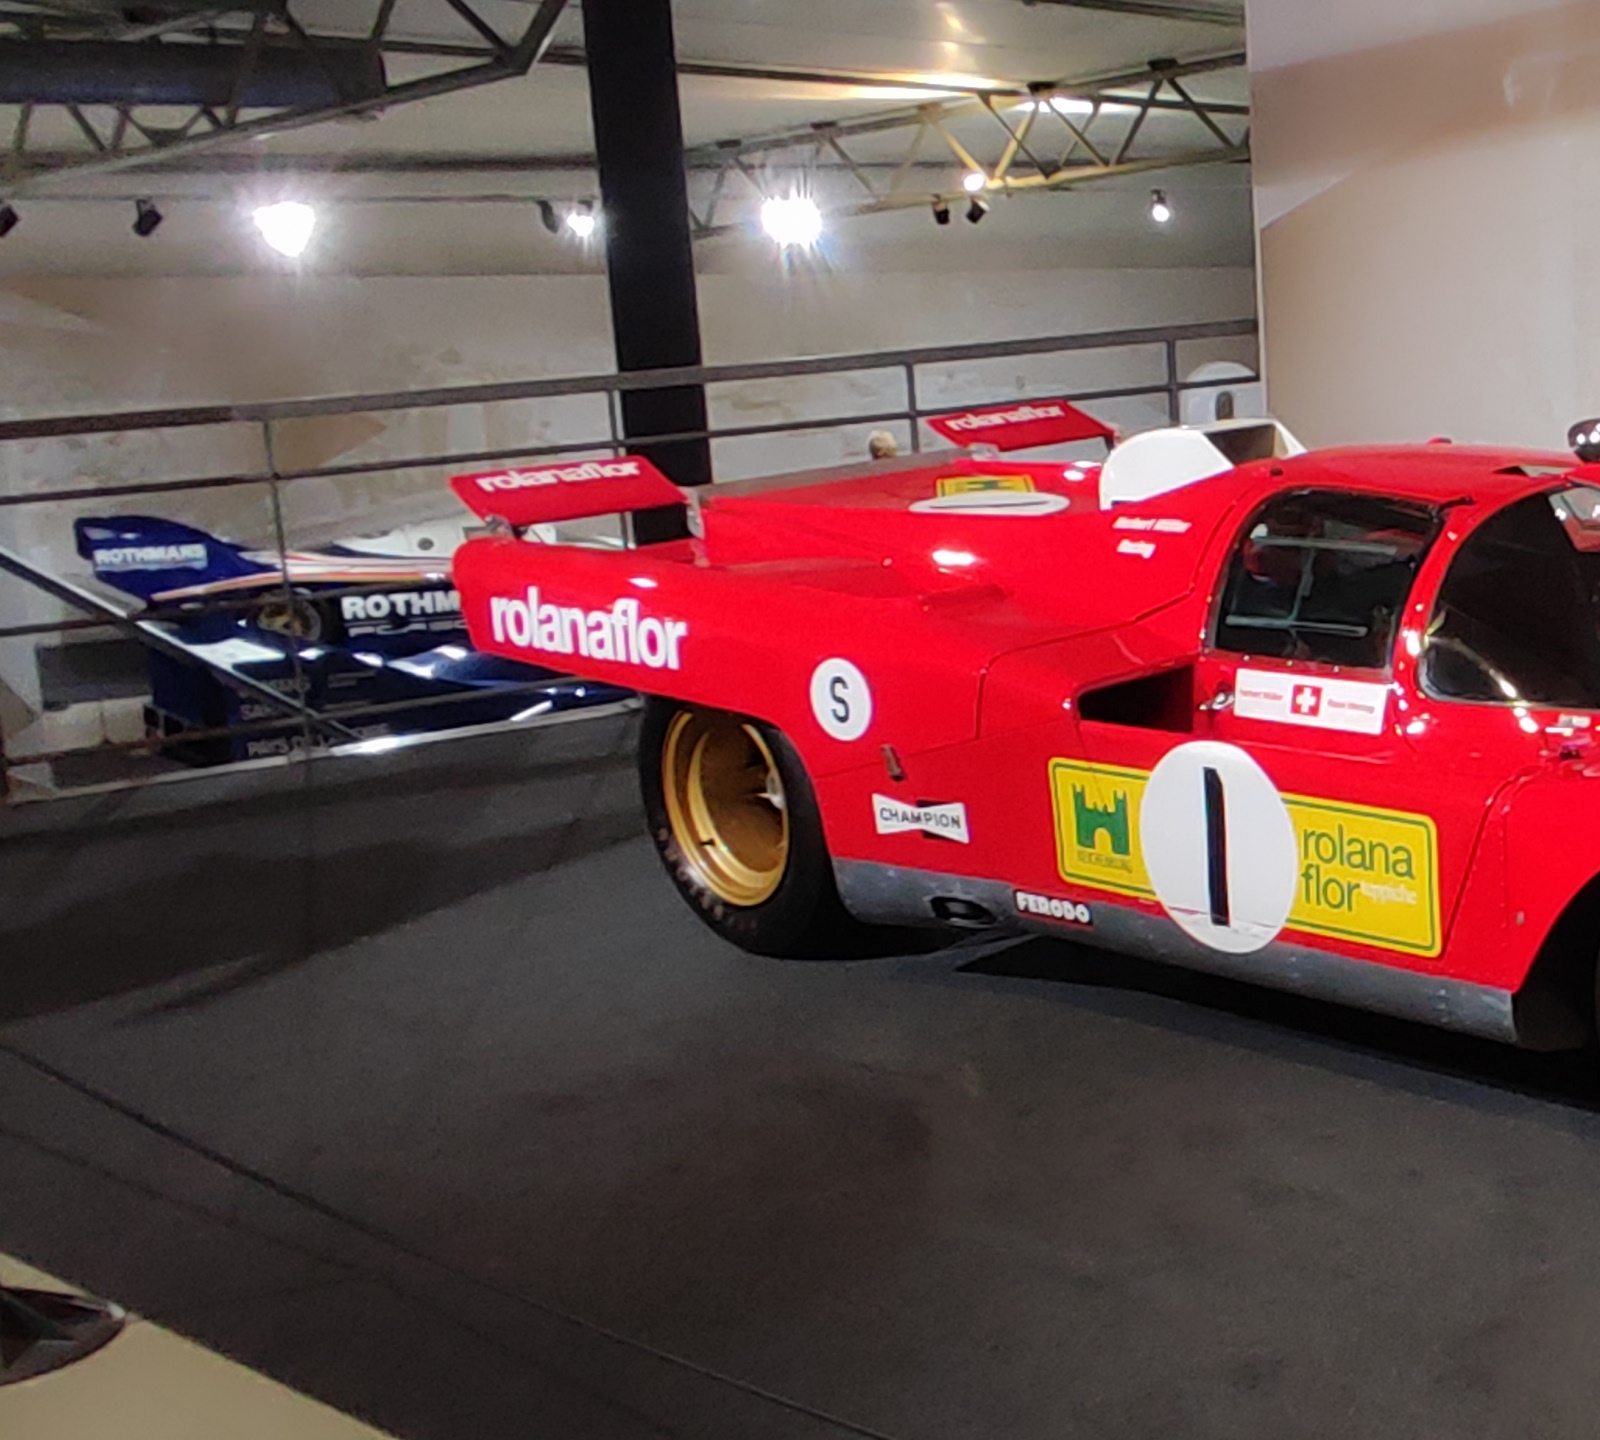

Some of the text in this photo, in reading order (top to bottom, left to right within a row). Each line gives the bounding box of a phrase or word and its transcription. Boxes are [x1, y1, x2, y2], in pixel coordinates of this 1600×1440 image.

[944, 405, 1067, 431] rolanaflor
[475, 461, 641, 493] rolanaflor
[341, 589, 461, 620] ROTHM
[489, 585, 689, 671] rolanaflor
[829, 675, 850, 724] S
[879, 806, 961, 830] CHAMPION
[1202, 766, 1231, 928] 1
[1302, 823, 1416, 881] rolana
[1014, 890, 1091, 924] FERODO
[1301, 863, 1361, 912] flor
